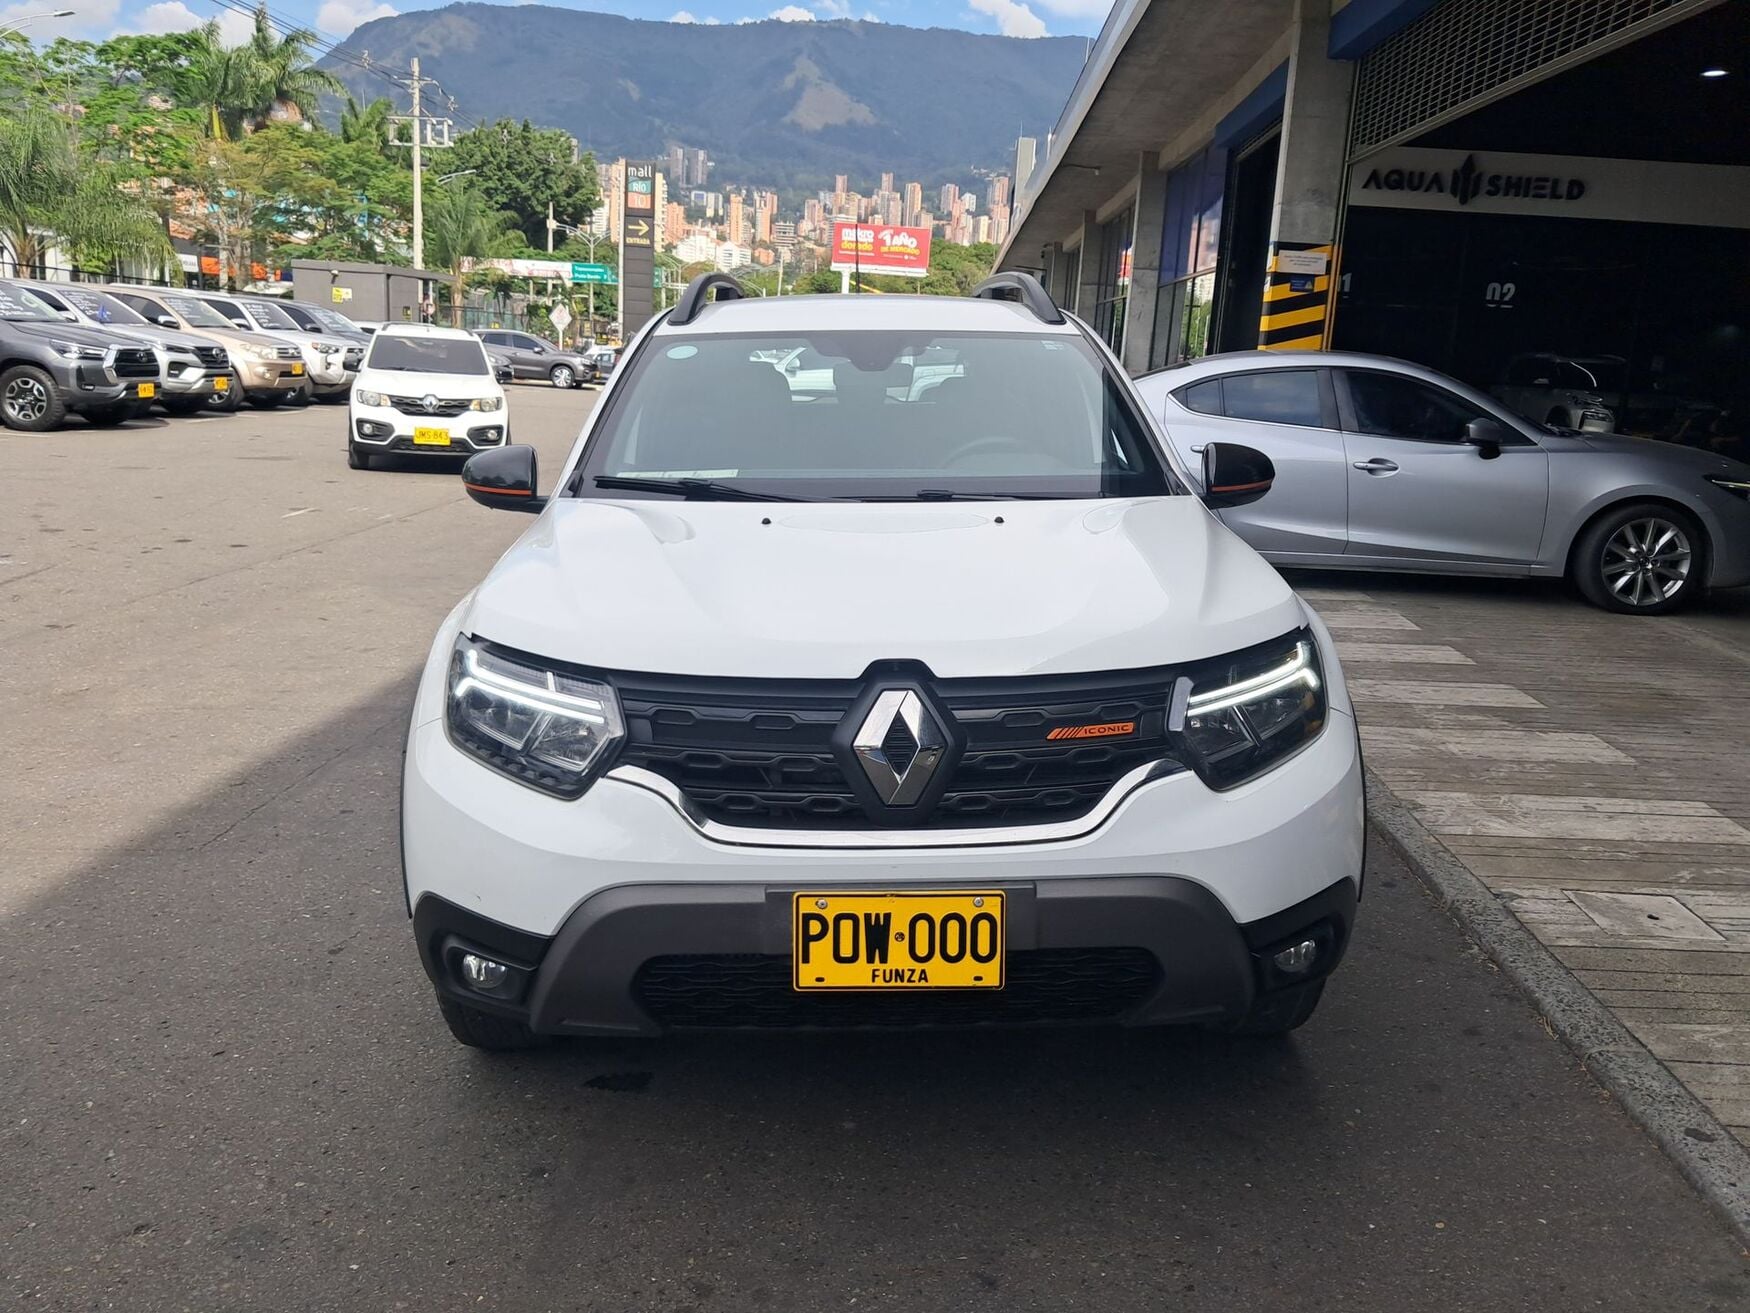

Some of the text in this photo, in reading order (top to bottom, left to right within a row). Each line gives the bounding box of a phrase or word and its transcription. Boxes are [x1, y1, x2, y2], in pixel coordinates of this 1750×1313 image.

[628, 165, 652, 177] mall
[1362, 169, 1585, 200] AQUA SHIELD
[1486, 282, 1516, 309] 02
[1083, 724, 1130, 735] ICONIC
[801, 912, 892, 964] POW
[871, 968, 929, 984] FUNZA
